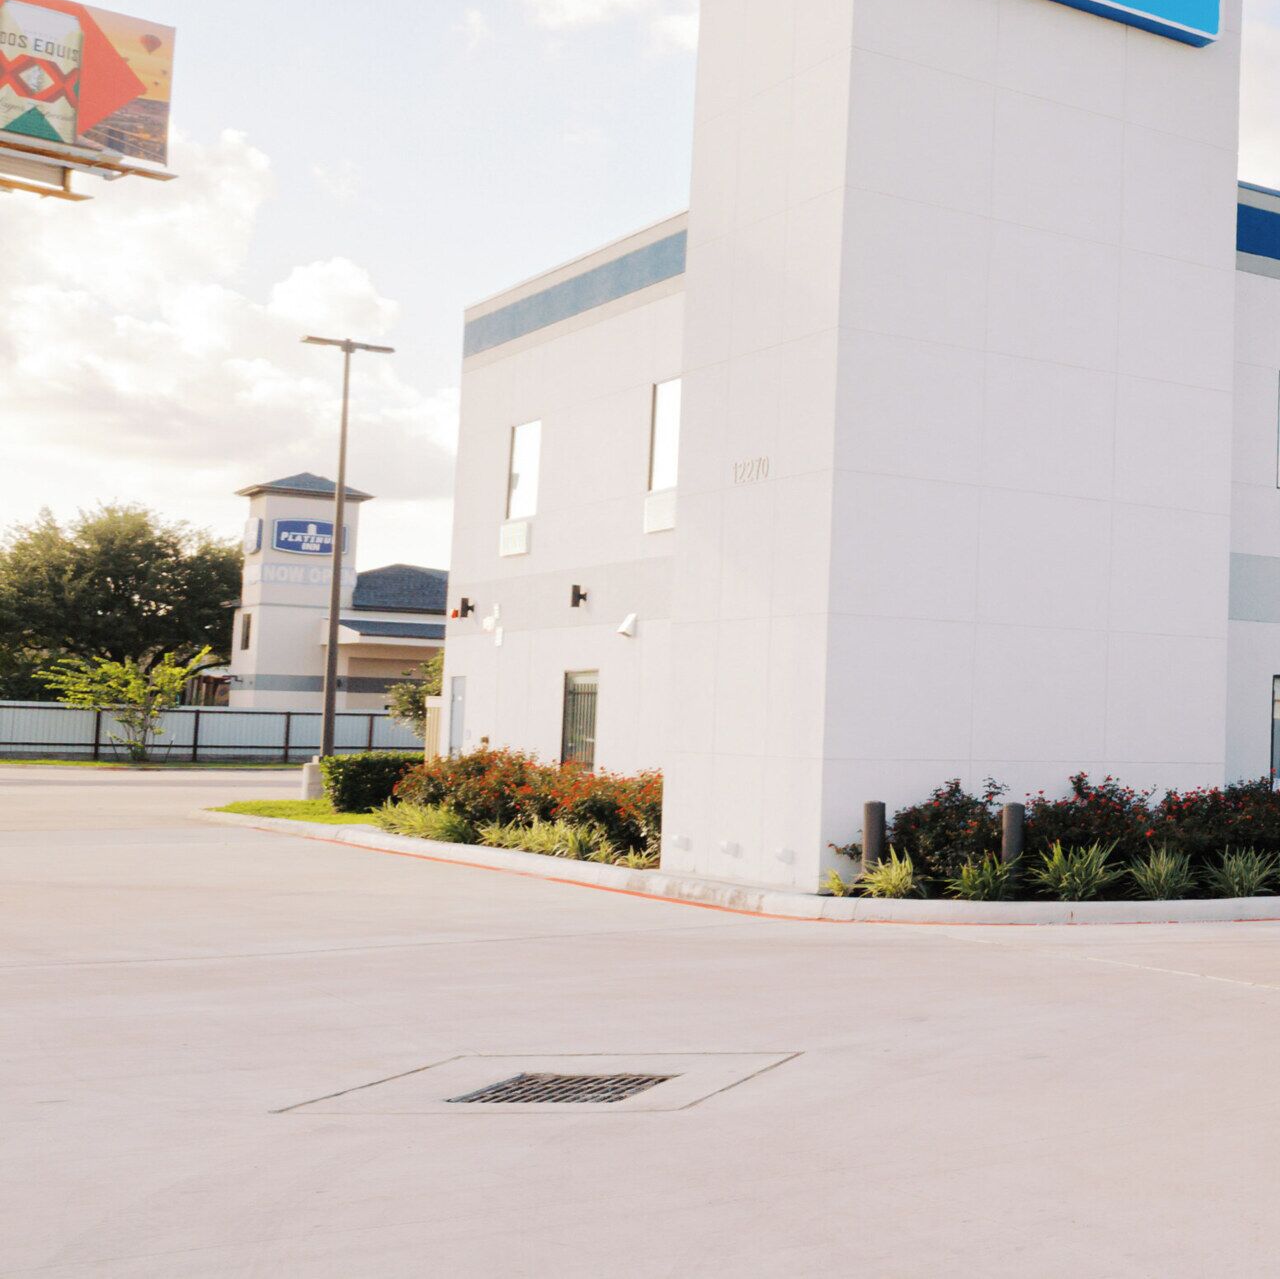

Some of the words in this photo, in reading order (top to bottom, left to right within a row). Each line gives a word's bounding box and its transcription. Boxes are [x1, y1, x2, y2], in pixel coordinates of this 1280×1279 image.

[33, 38, 80, 62] EQUIS
[280, 531, 334, 545] PLATINU
[263, 564, 304, 583] NOW
[309, 567, 356, 586] OPN
